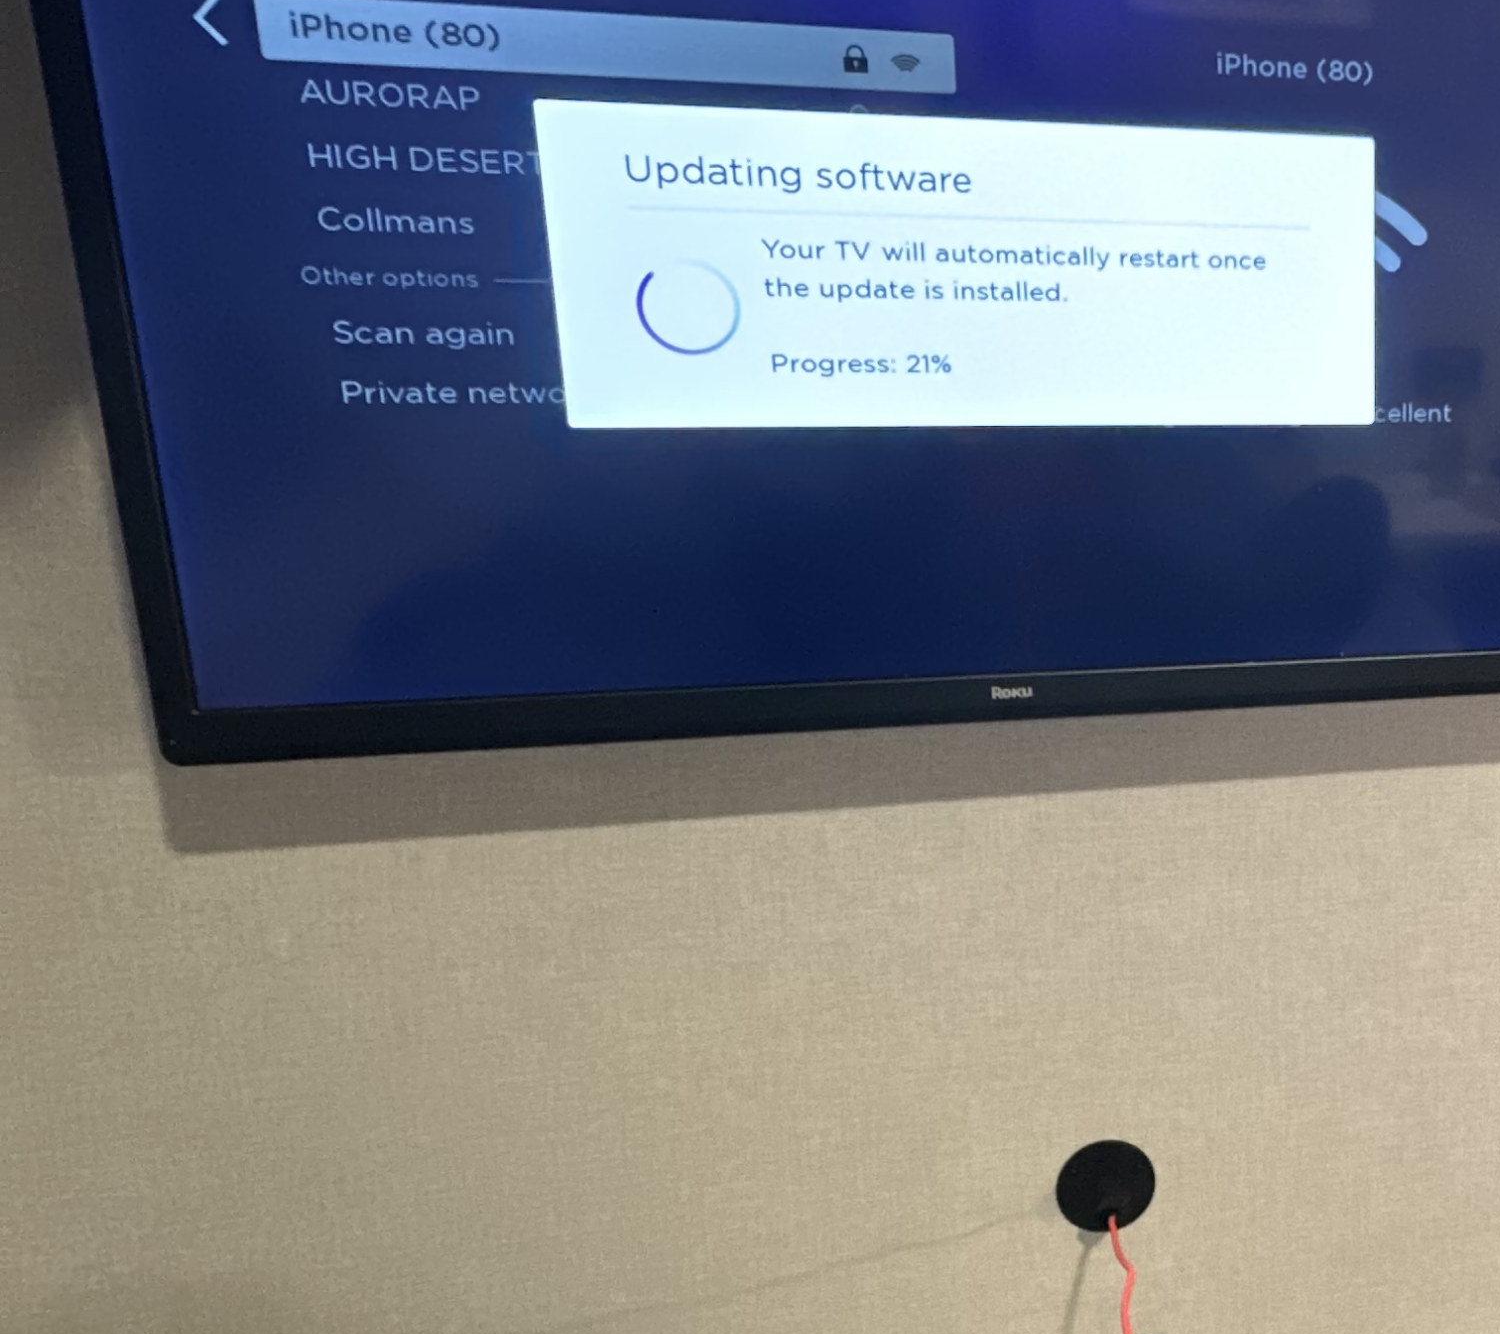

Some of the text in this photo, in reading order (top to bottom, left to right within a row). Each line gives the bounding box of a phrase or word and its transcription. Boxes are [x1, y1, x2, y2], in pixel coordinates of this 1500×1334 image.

[289, 11, 500, 52] iPhone (80)
[1216, 51, 1373, 86] iPhone (80)
[300, 79, 480, 111] AURORAP
[307, 142, 398, 171] HIGH
[624, 154, 972, 194] Updating software
[317, 206, 475, 235] Collmans
[761, 238, 1266, 271] Your TV will automatically restart once
[300, 265, 479, 289] Other options
[764, 277, 1069, 303] the update is installed.
[332, 319, 515, 350] Scan again
[771, 353, 952, 378] Progress: 21%
[340, 380, 457, 404] Private
